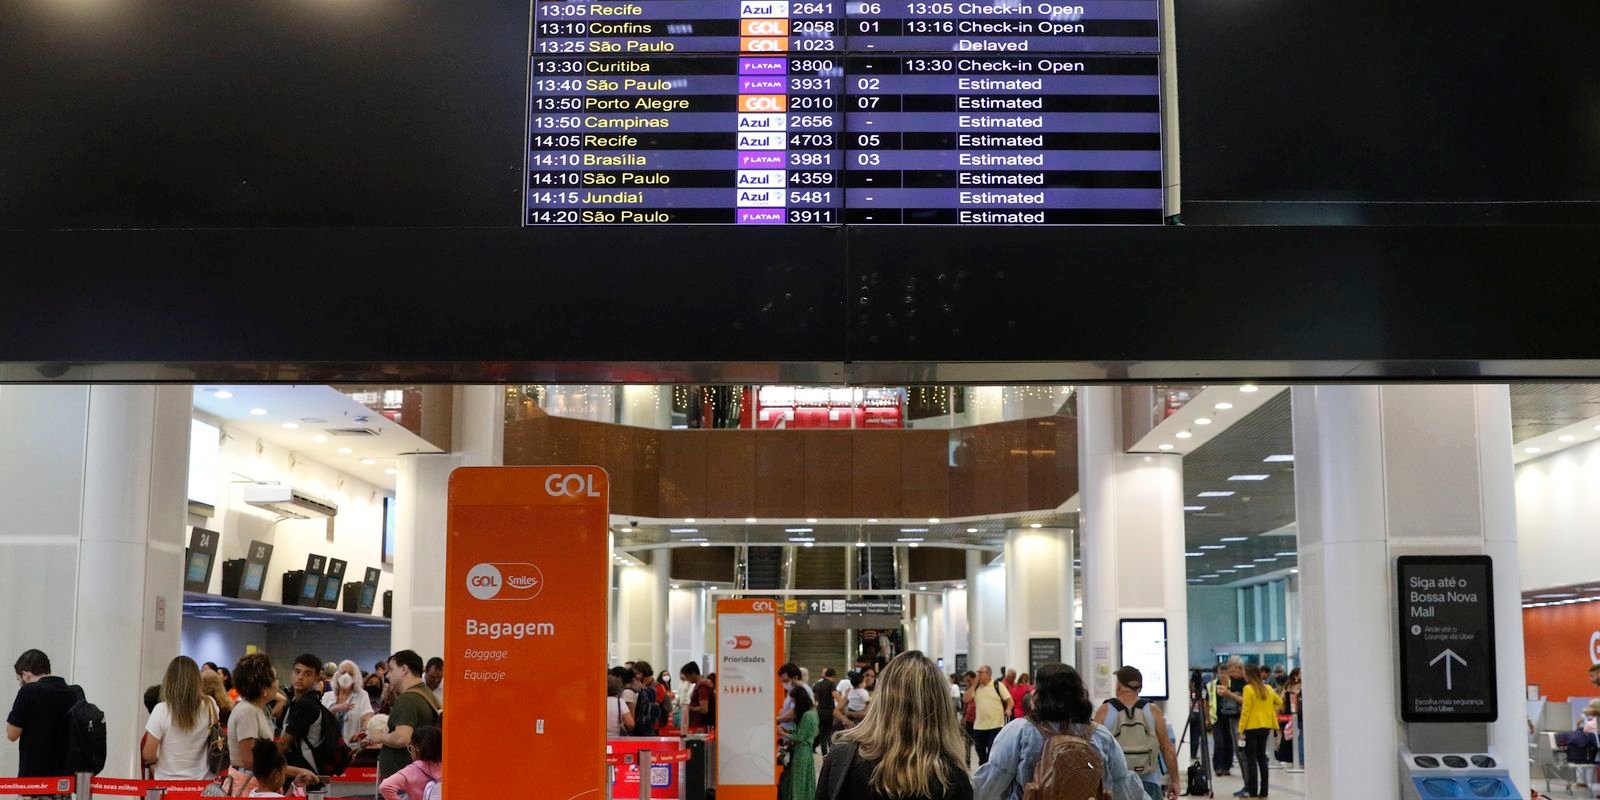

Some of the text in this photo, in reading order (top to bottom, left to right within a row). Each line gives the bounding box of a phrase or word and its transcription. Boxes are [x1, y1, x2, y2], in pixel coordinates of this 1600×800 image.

[541, 2, 1083, 17] 13:05 Recife Azul 2641 06 13:05 Check-in Open
[541, 21, 1084, 35] 13:10 Confins GOL 2058 01 13:16 Check-in Open
[540, 41, 585, 52] 13:25
[589, 41, 621, 52] São
[627, 41, 674, 51] Paulo
[747, 39, 784, 52] GOL
[794, 40, 834, 50] 1023
[958, 40, 1028, 51] Delayed
[538, 61, 582, 72] 13:30
[587, 61, 649, 72] Curitiba
[792, 60, 834, 72] 3800
[907, 60, 952, 71] 13:30
[958, 60, 1031, 71] Check-in
[1038, 60, 1084, 73] Open
[537, 80, 582, 91] 13:40
[586, 80, 617, 90] São
[625, 79, 673, 90] Paulo
[792, 79, 830, 89] 3931
[858, 79, 879, 89] 02
[959, 78, 1041, 89] Estimated
[536, 97, 1042, 111] 13:50 Porto Alegre GOL 2010 07 Estimated
[536, 117, 580, 128] 13:50
[585, 117, 669, 130] Campinas
[740, 118, 769, 127] Azul
[791, 116, 832, 127] 2656
[959, 116, 1042, 127] Estimated
[535, 135, 1042, 146] 14:05 Recife Azul 4703 05 Estimated
[534, 154, 579, 165] 14:10
[584, 154, 646, 165] Brasília
[791, 154, 830, 165] 3981
[858, 154, 880, 165] 03
[960, 154, 1043, 165] Estimated
[534, 173, 579, 184] 14:10
[583, 173, 614, 184] São
[623, 173, 669, 184] Paulo
[739, 174, 769, 184] Azul
[790, 173, 832, 184] 4359
[960, 173, 1043, 184] Estimated
[533, 192, 578, 203] 14:15
[582, 192, 642, 203] Jundiaí
[741, 192, 768, 201] Azul
[791, 192, 830, 203] 5481
[960, 192, 1044, 203] Estimated
[532, 211, 577, 222] 14:20
[582, 211, 614, 222] São
[622, 211, 669, 222] Paulo
[791, 211, 829, 222] 3911
[960, 211, 1044, 223] Estimated
[545, 473, 600, 497] GOL
[200, 534, 209, 548] 24
[471, 575, 538, 589] GOL Smiles
[1410, 576, 1467, 590] Siga até o
[1410, 591, 1478, 602] Bossa Nova
[753, 601, 774, 611] GOL
[1410, 606, 1435, 617] Mall
[465, 619, 555, 640] Bagagem
[464, 649, 508, 660] Baggage
[464, 670, 506, 682] Equipaje
